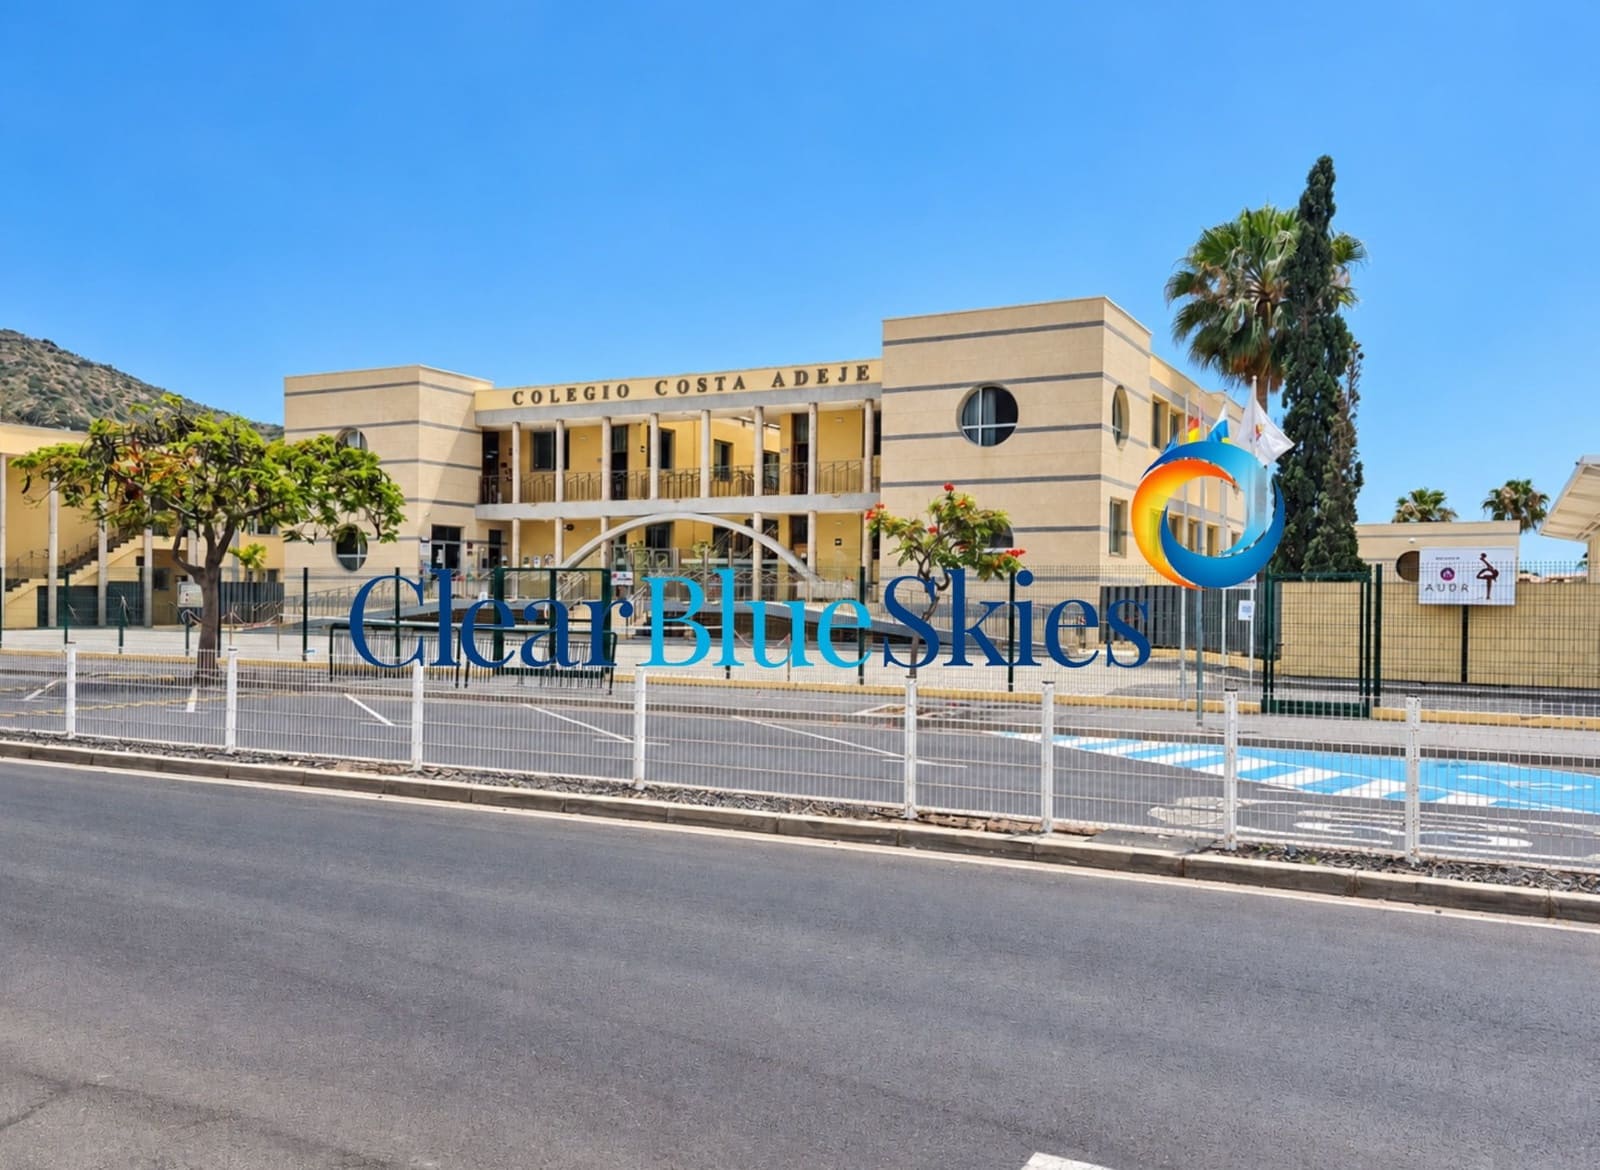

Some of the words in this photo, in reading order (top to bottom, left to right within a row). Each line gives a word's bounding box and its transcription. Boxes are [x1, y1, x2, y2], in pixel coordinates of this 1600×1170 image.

[512, 383, 630, 406] COLEGIO
[655, 376, 746, 396] COSTA
[771, 364, 871, 388] ADEJE
